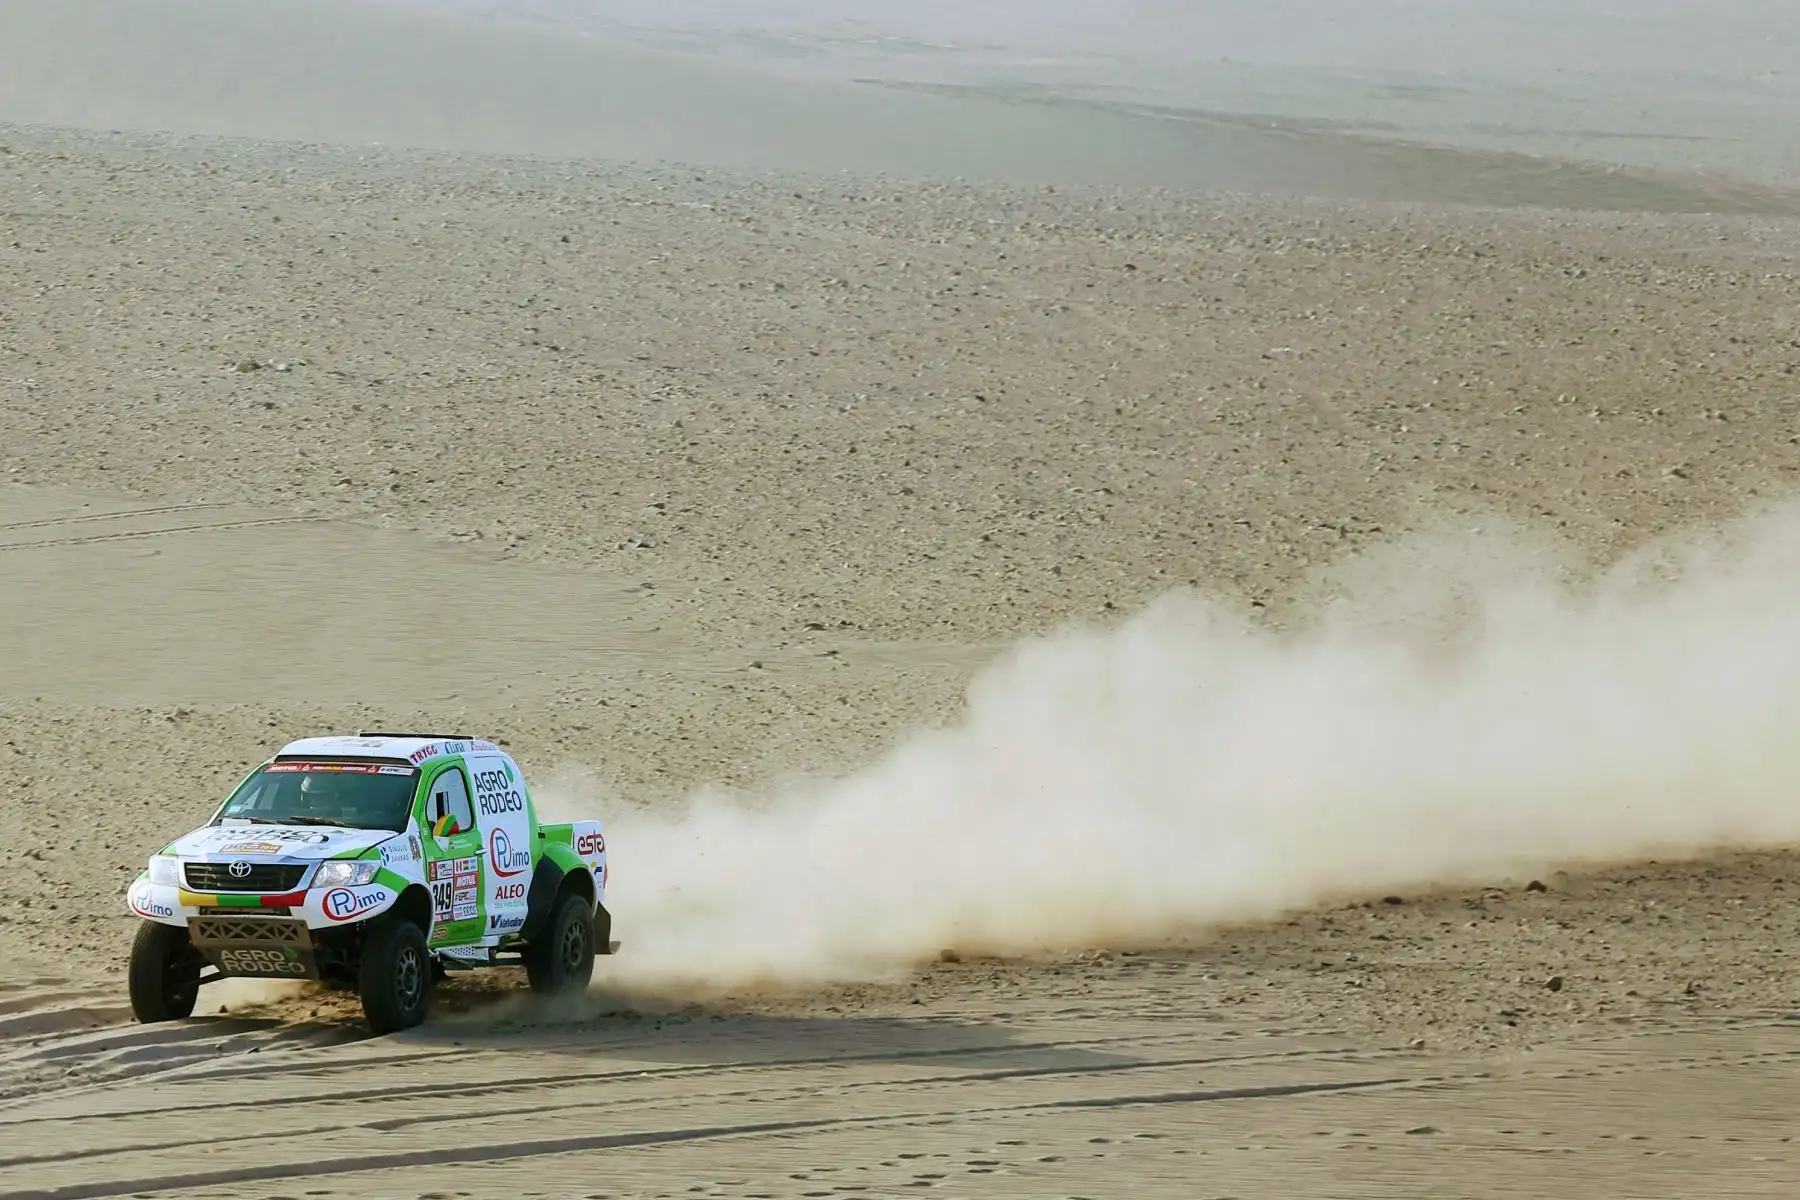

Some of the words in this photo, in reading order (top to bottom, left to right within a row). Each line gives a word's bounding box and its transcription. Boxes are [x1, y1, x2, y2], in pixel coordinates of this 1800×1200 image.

[474, 769, 508, 793] AGRO
[480, 791, 522, 815] RODEO
[456, 874, 476, 887] MOTUL
[432, 882, 452, 911] 349
[495, 883, 525, 900] ALEO
[221, 949, 285, 962] AGRO
[222, 960, 306, 974] RODEO
